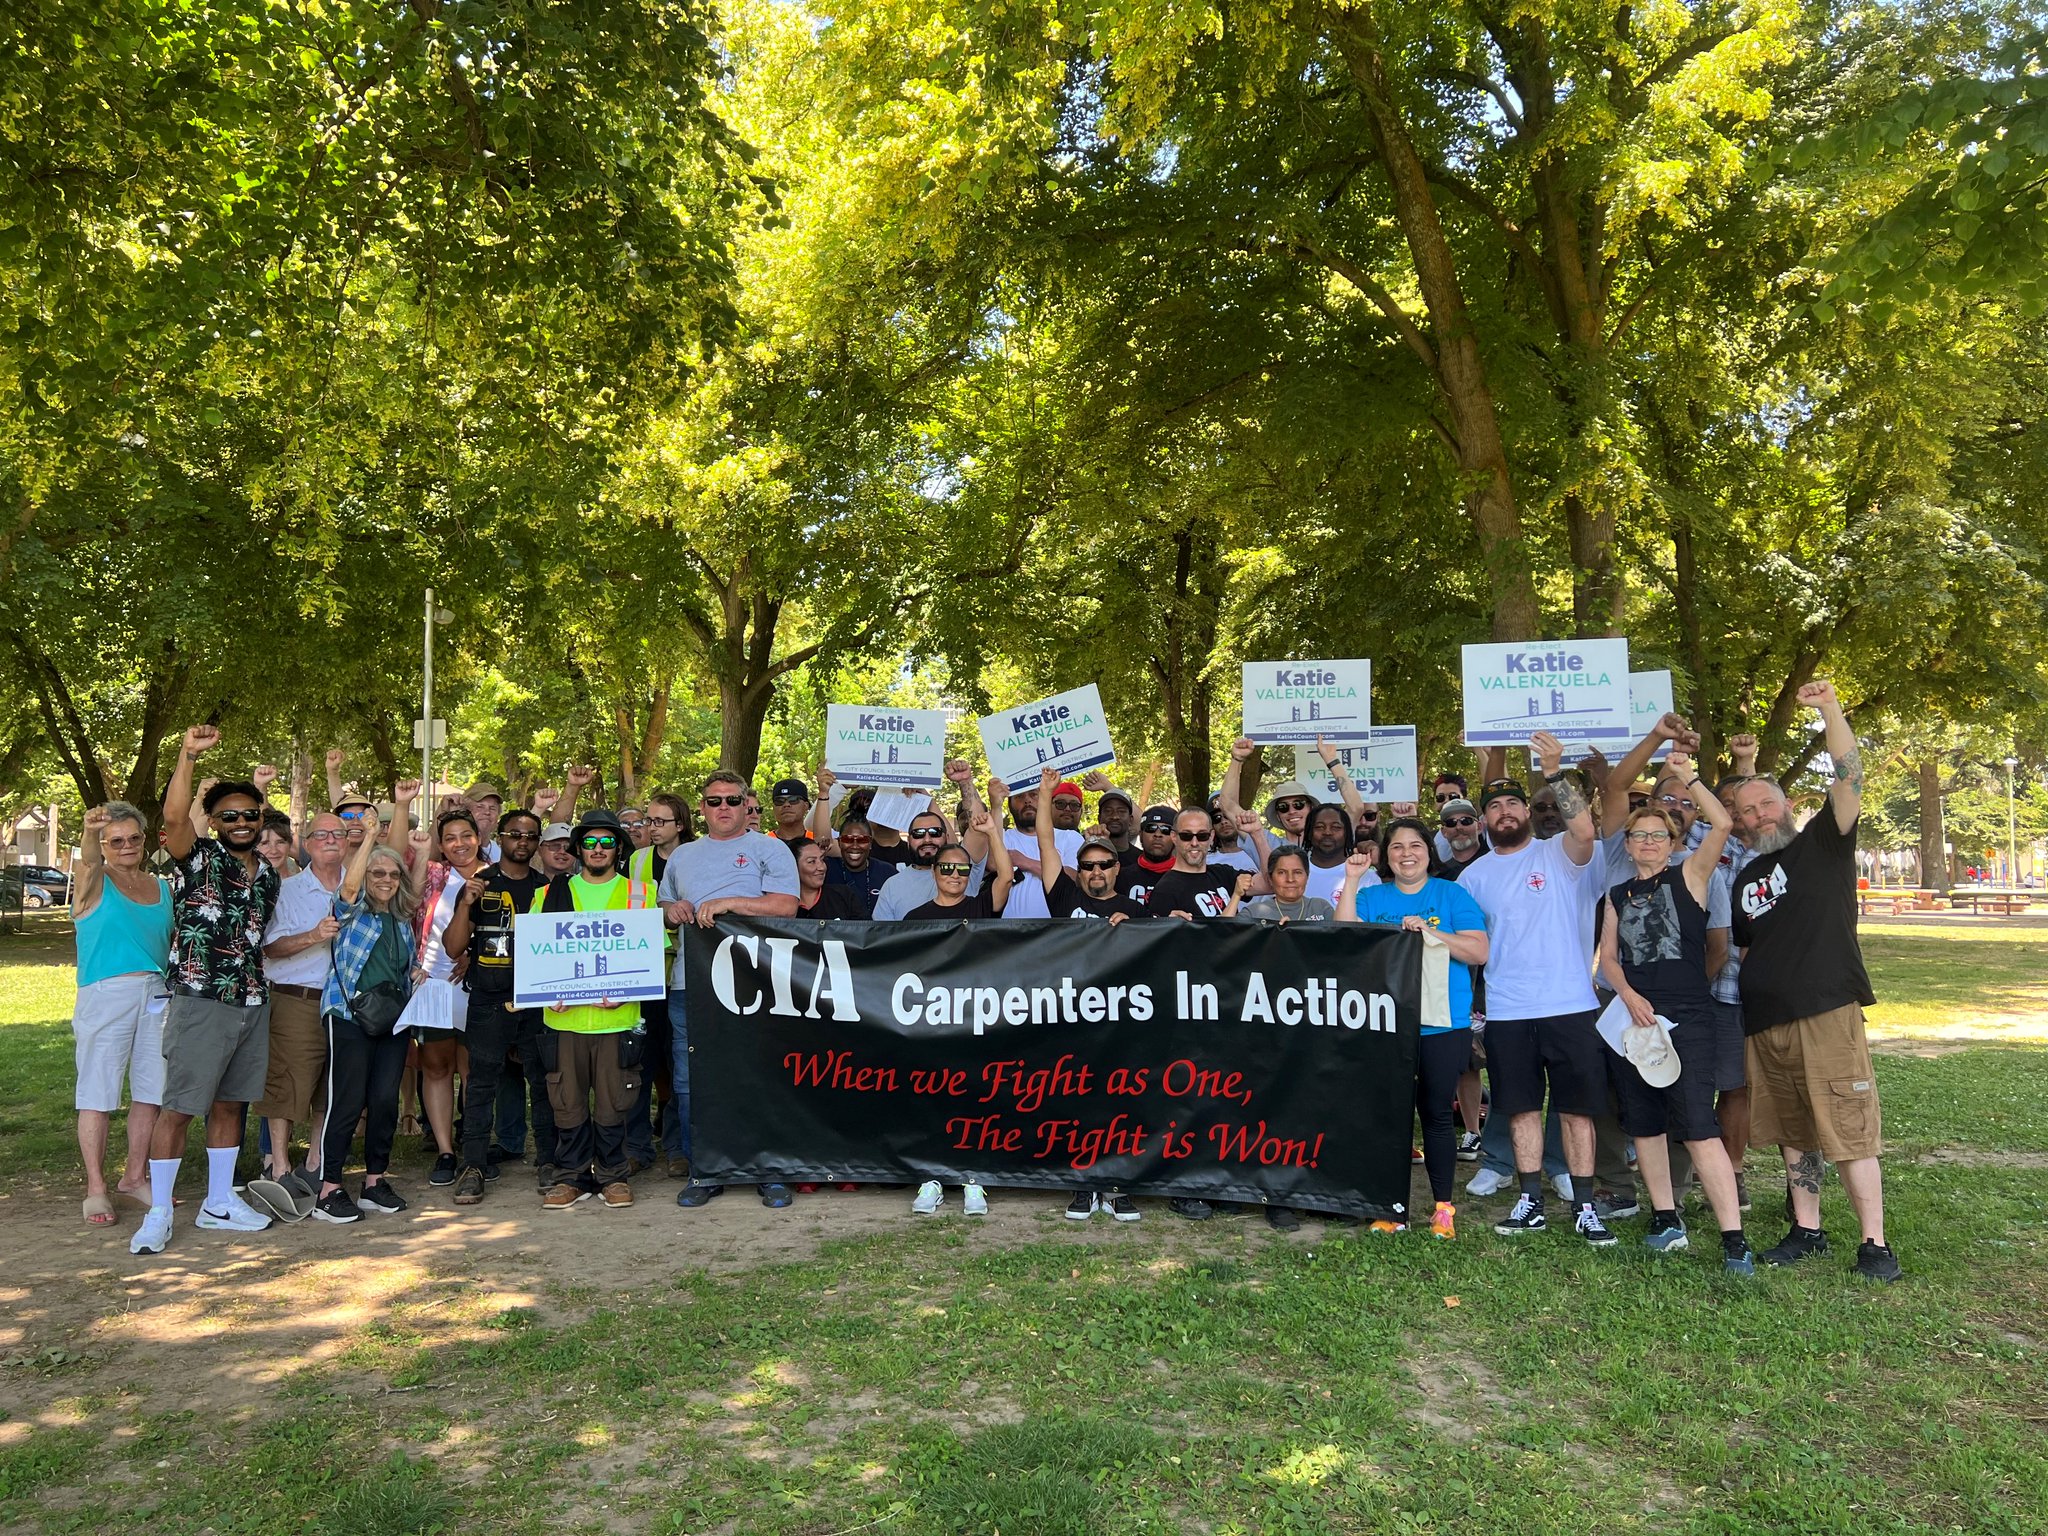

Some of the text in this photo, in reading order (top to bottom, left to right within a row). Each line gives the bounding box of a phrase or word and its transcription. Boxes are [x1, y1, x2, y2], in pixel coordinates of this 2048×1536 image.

[1507, 651, 1583, 673] Katie
[1277, 669, 1336, 686] Katie
[1480, 673, 1611, 689] VALENZUELA
[1256, 687, 1357, 700] VALENZUELA
[860, 714, 914, 732] Katie
[1012, 705, 1070, 733] Katie
[839, 730, 932, 745] VALENZUELA
[996, 714, 1093, 751] VALENZUELA
[1061, 753, 1087, 765] DISTRICT
[1308, 767, 1404, 779] VALENZELA
[1328, 779, 1384, 794] Kae
[556, 920, 625, 940] Katie
[530, 938, 648, 955] VALENZUELA
[560, 982, 592, 990] COUNCIL
[711, 934, 1396, 1035] CIA Carpenters In Action
[556, 990, 624, 999] Katie4Council.com
[784, 1050, 1252, 1112] When we Fight as One,
[946, 1114, 1325, 1170] The Fight is Won!
